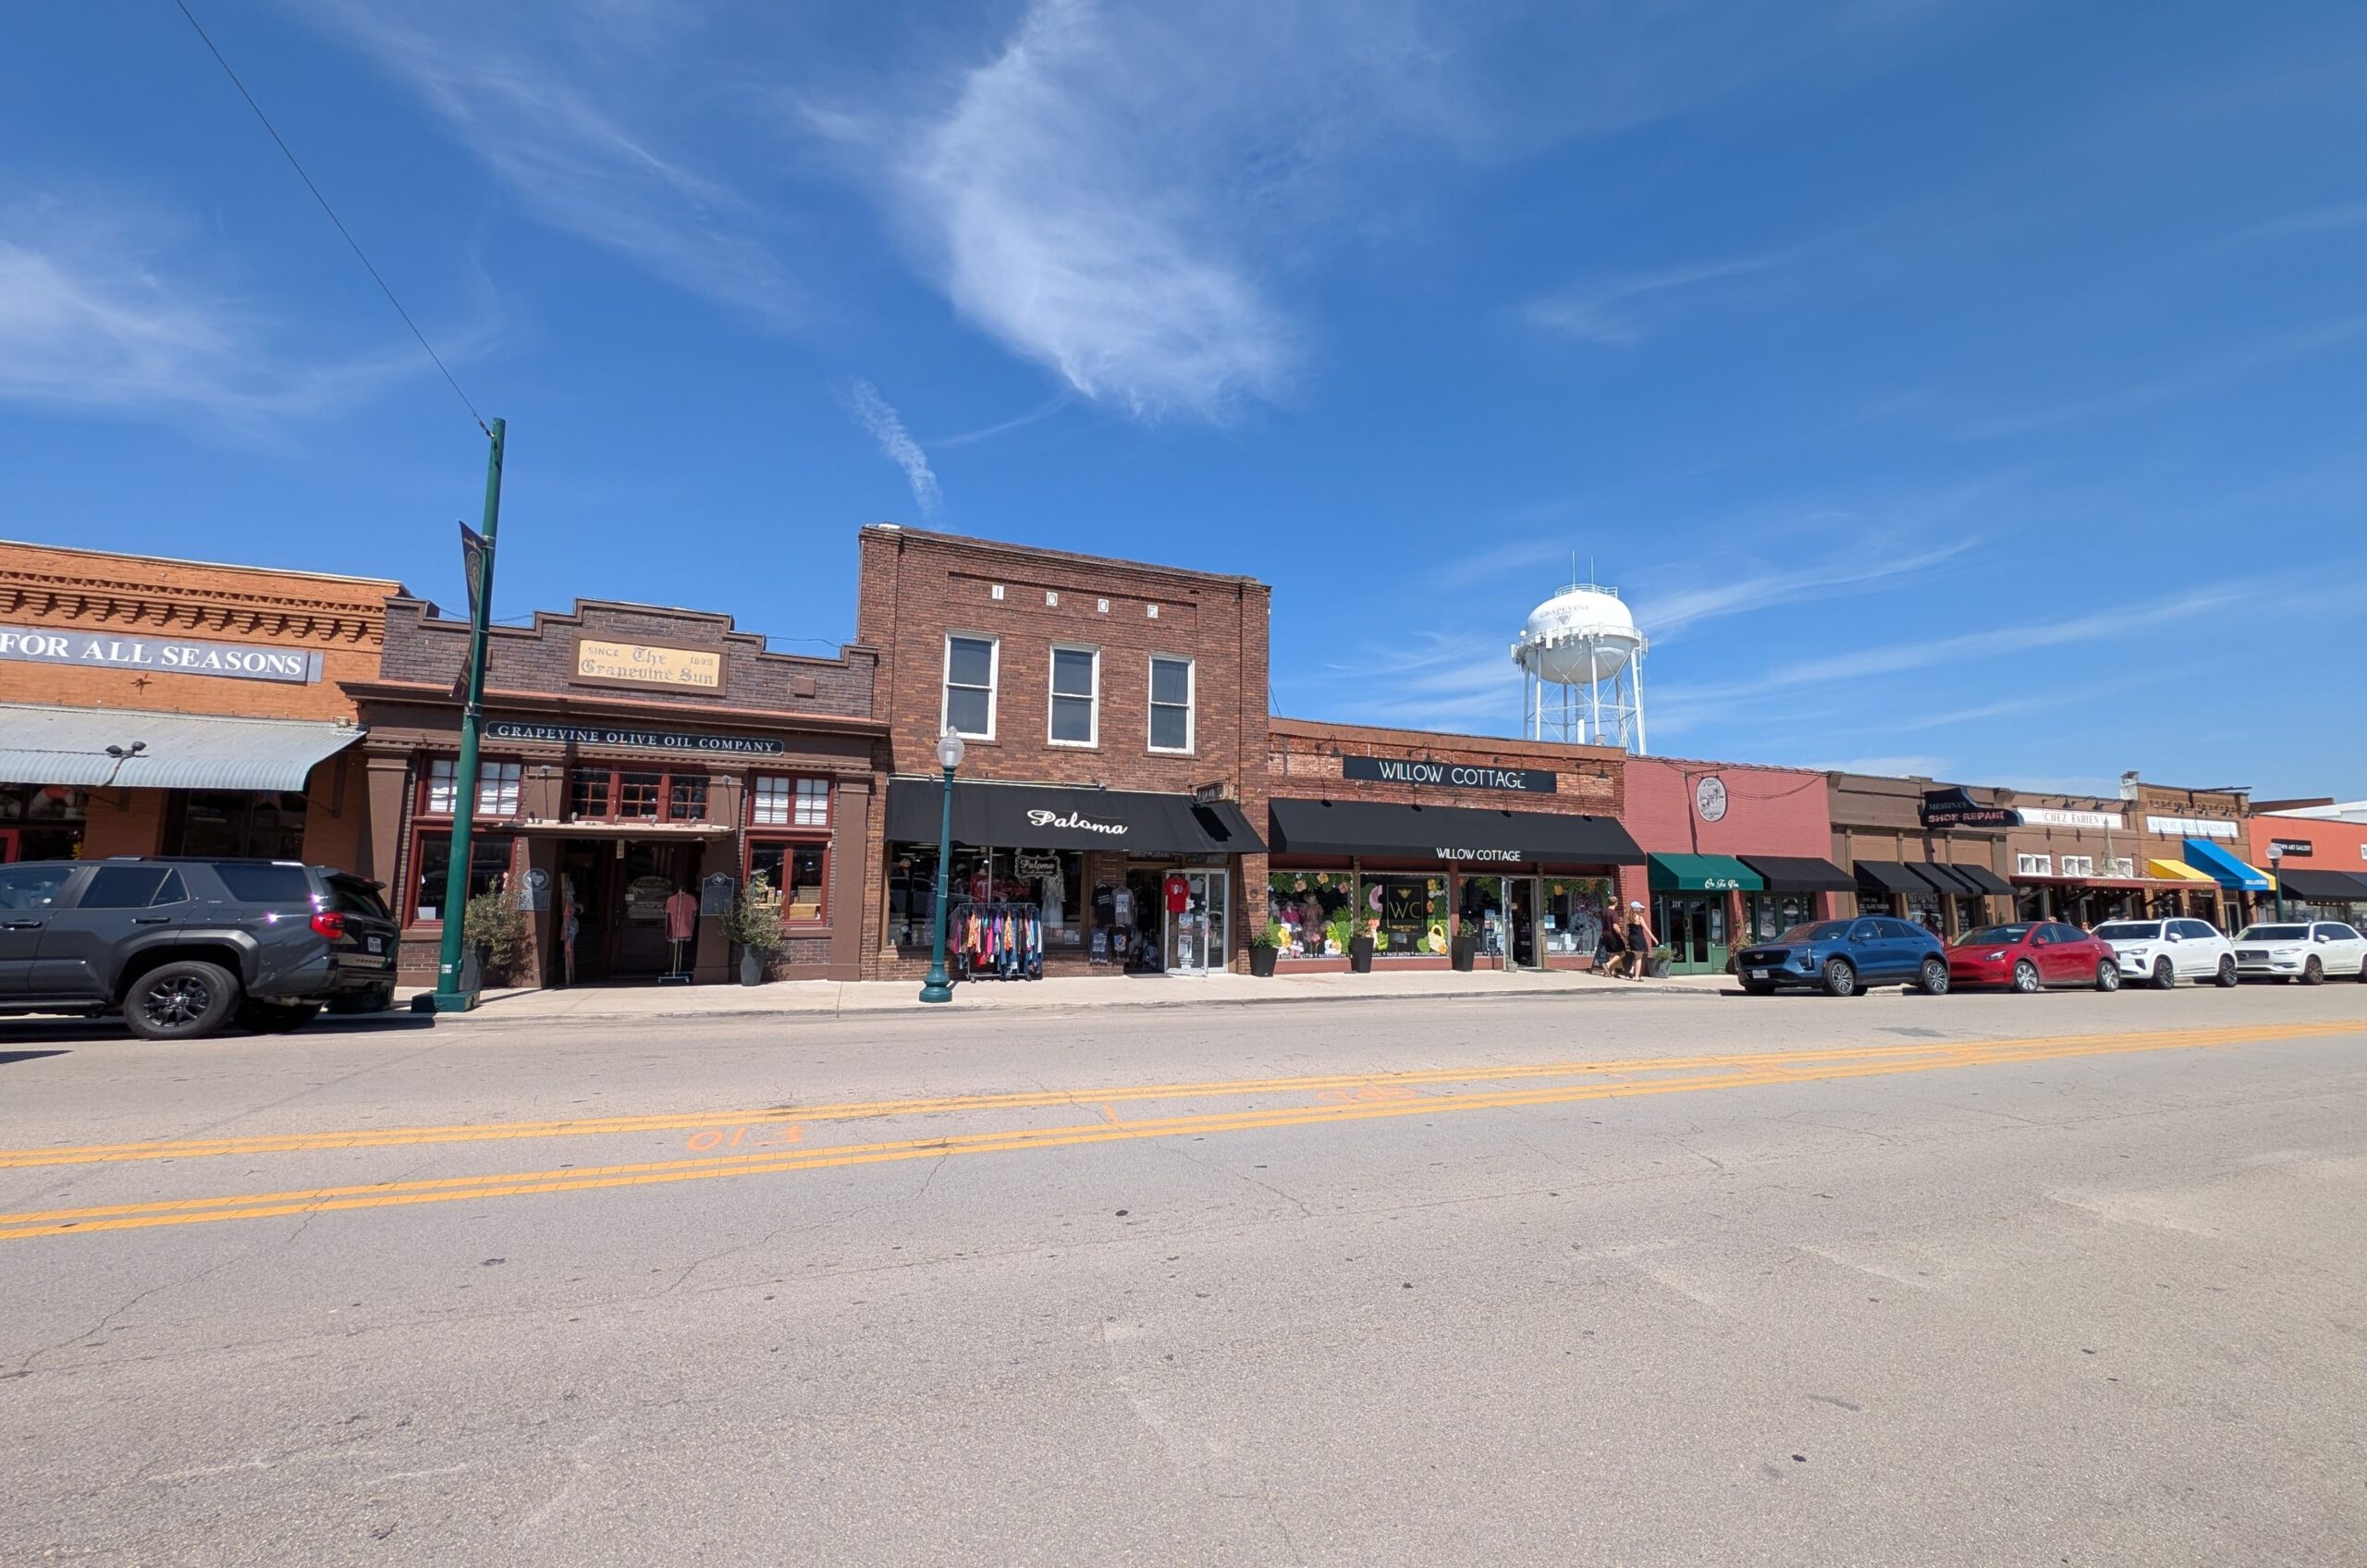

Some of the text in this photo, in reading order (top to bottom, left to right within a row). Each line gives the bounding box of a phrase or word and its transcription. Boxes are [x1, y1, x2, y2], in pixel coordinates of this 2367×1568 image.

[0, 632, 302, 675] FOR ALL SEASONS
[587, 646, 619, 657] SINCE
[632, 647, 666, 667] The
[690, 656, 714, 667] 1895
[580, 658, 714, 685] Grapevine Sun
[497, 725, 775, 752] GRAPEVINE OLIVE OIL COMPANY
[1379, 761, 1527, 789] WILLOW COTTAGE
[1929, 802, 1968, 810] MESSINA'S
[1026, 809, 1128, 835] Paloma
[1928, 811, 2005, 823] SHOE REPAIR
[2044, 812, 2099, 824] CHEZ FABIEN
[1436, 848, 1521, 862] WILLOW COTTAGE
[1020, 858, 1055, 870] Paloma
[1389, 901, 1421, 919] WC
